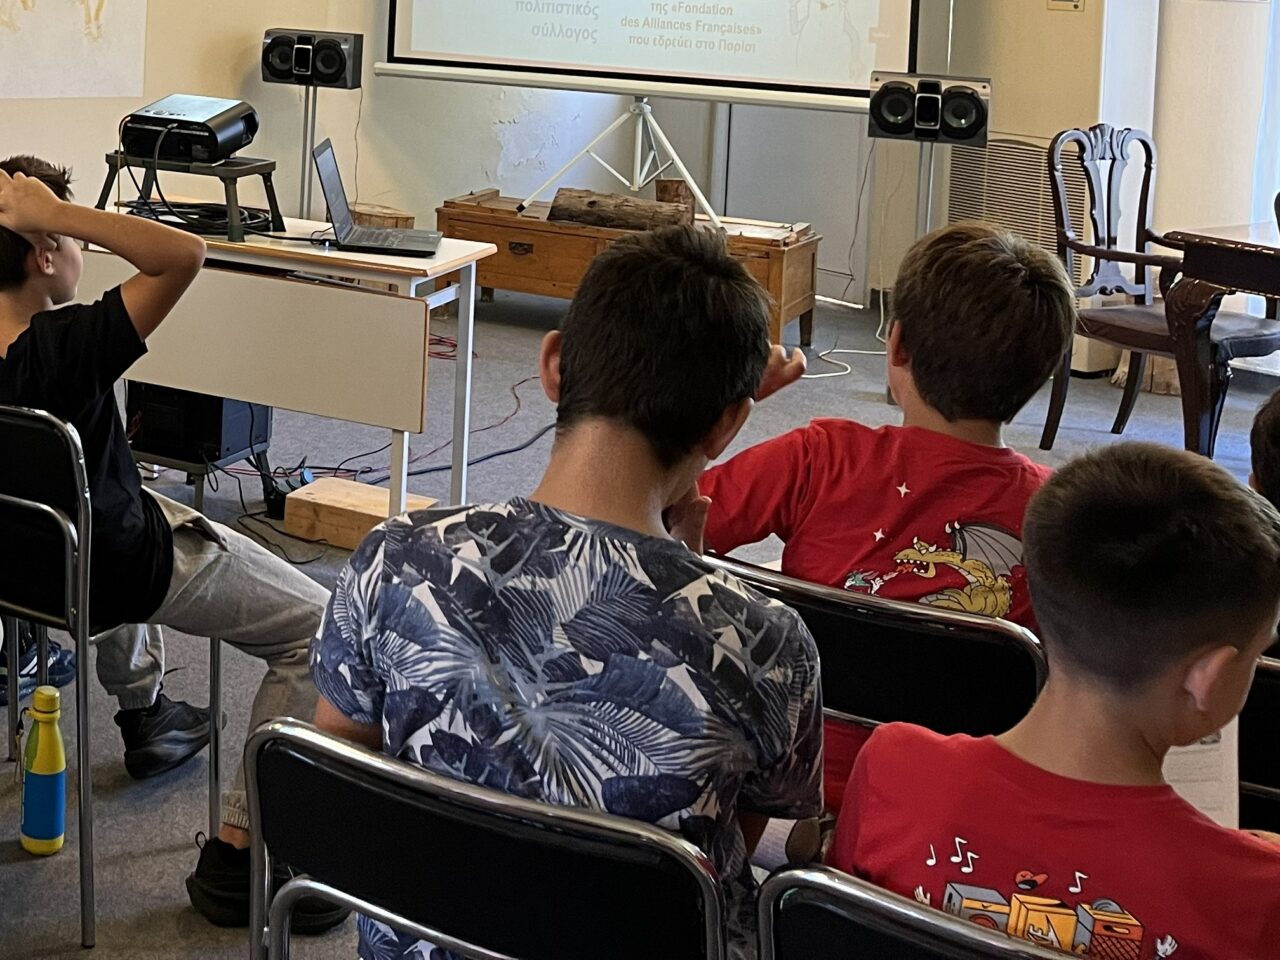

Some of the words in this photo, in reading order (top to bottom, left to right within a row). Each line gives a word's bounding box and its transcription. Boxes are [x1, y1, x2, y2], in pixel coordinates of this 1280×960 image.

[650, 2, 669, 15] της
[620, 15, 640, 28] des
[642, 16, 692, 32] Alliances
[531, 22, 598, 44] σύλλογος
[628, 35, 650, 46] που
[652, 34, 693, 50] εδρεύει
[695, 40, 715, 50] στο
[718, 38, 757, 54] Παρίσι
